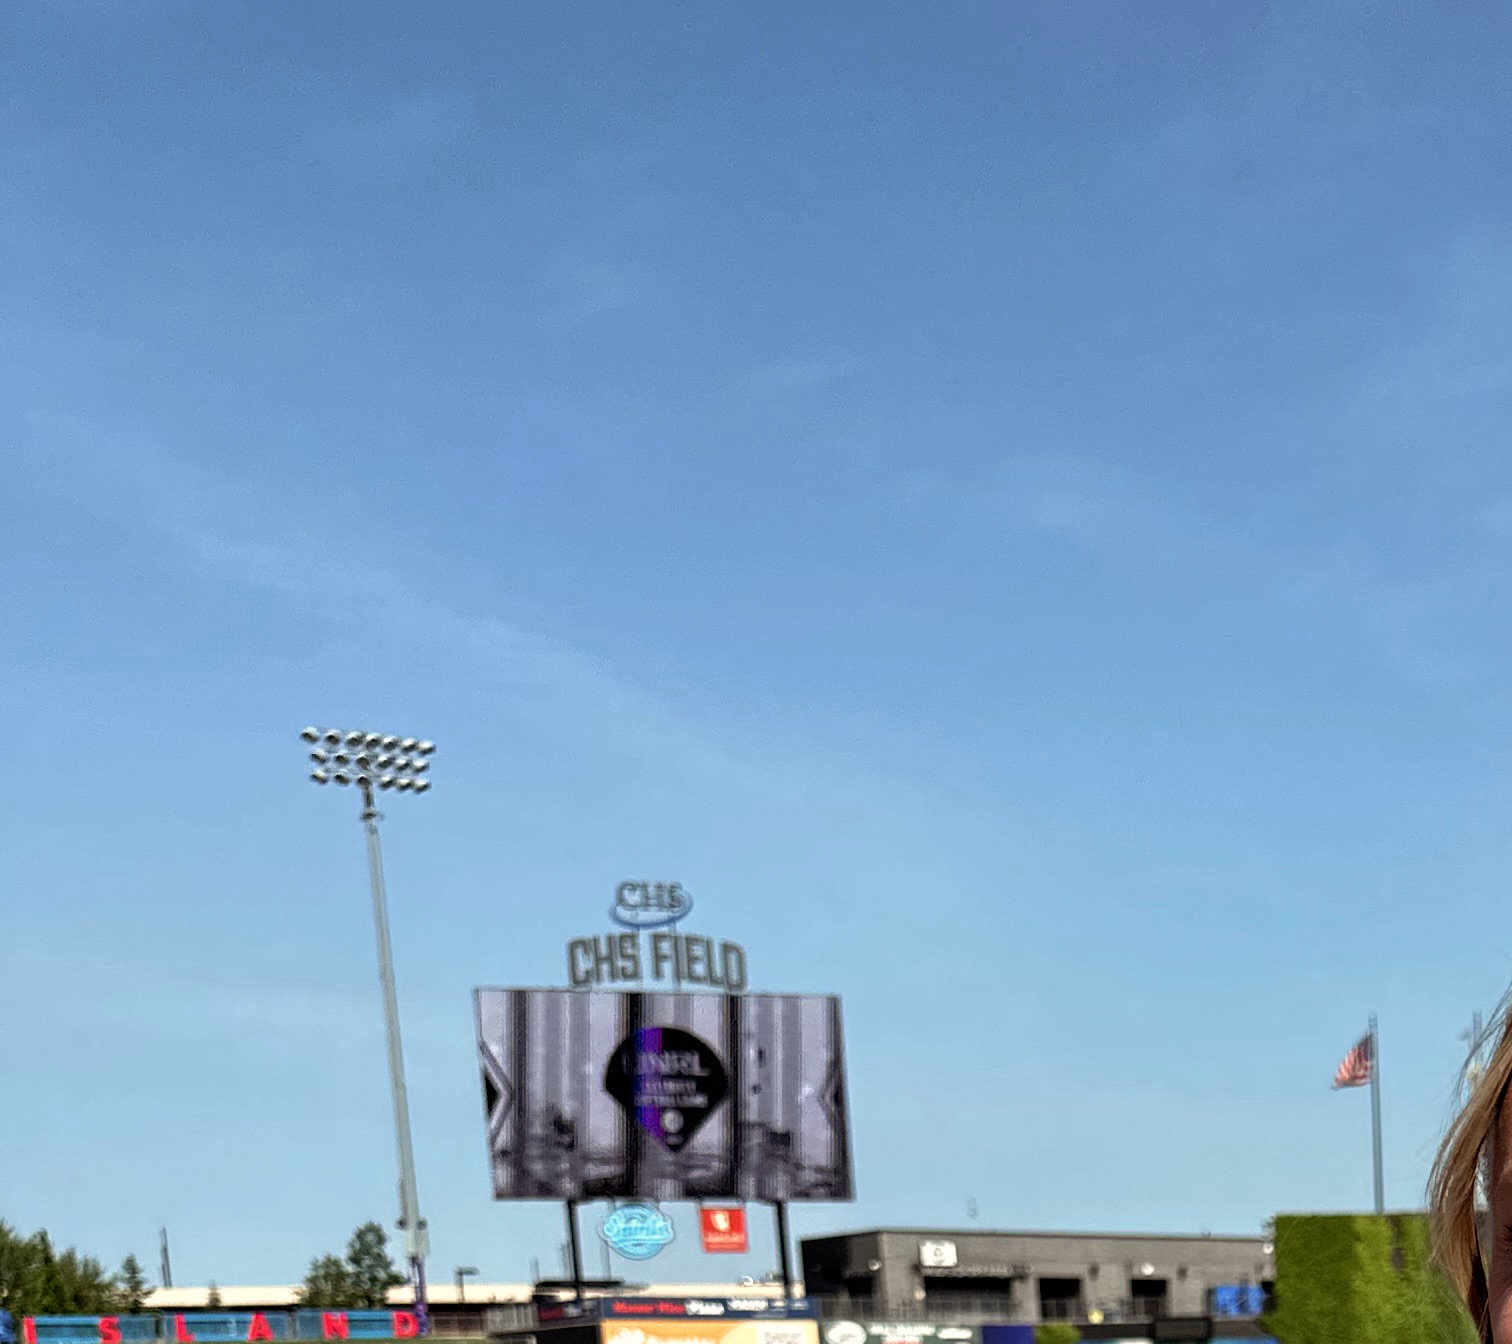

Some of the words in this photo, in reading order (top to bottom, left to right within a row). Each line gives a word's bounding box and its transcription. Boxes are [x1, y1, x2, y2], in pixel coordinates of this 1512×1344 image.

[616, 881, 682, 911] CHS
[568, 935, 640, 987] CHS
[648, 934, 747, 989] FIELD
